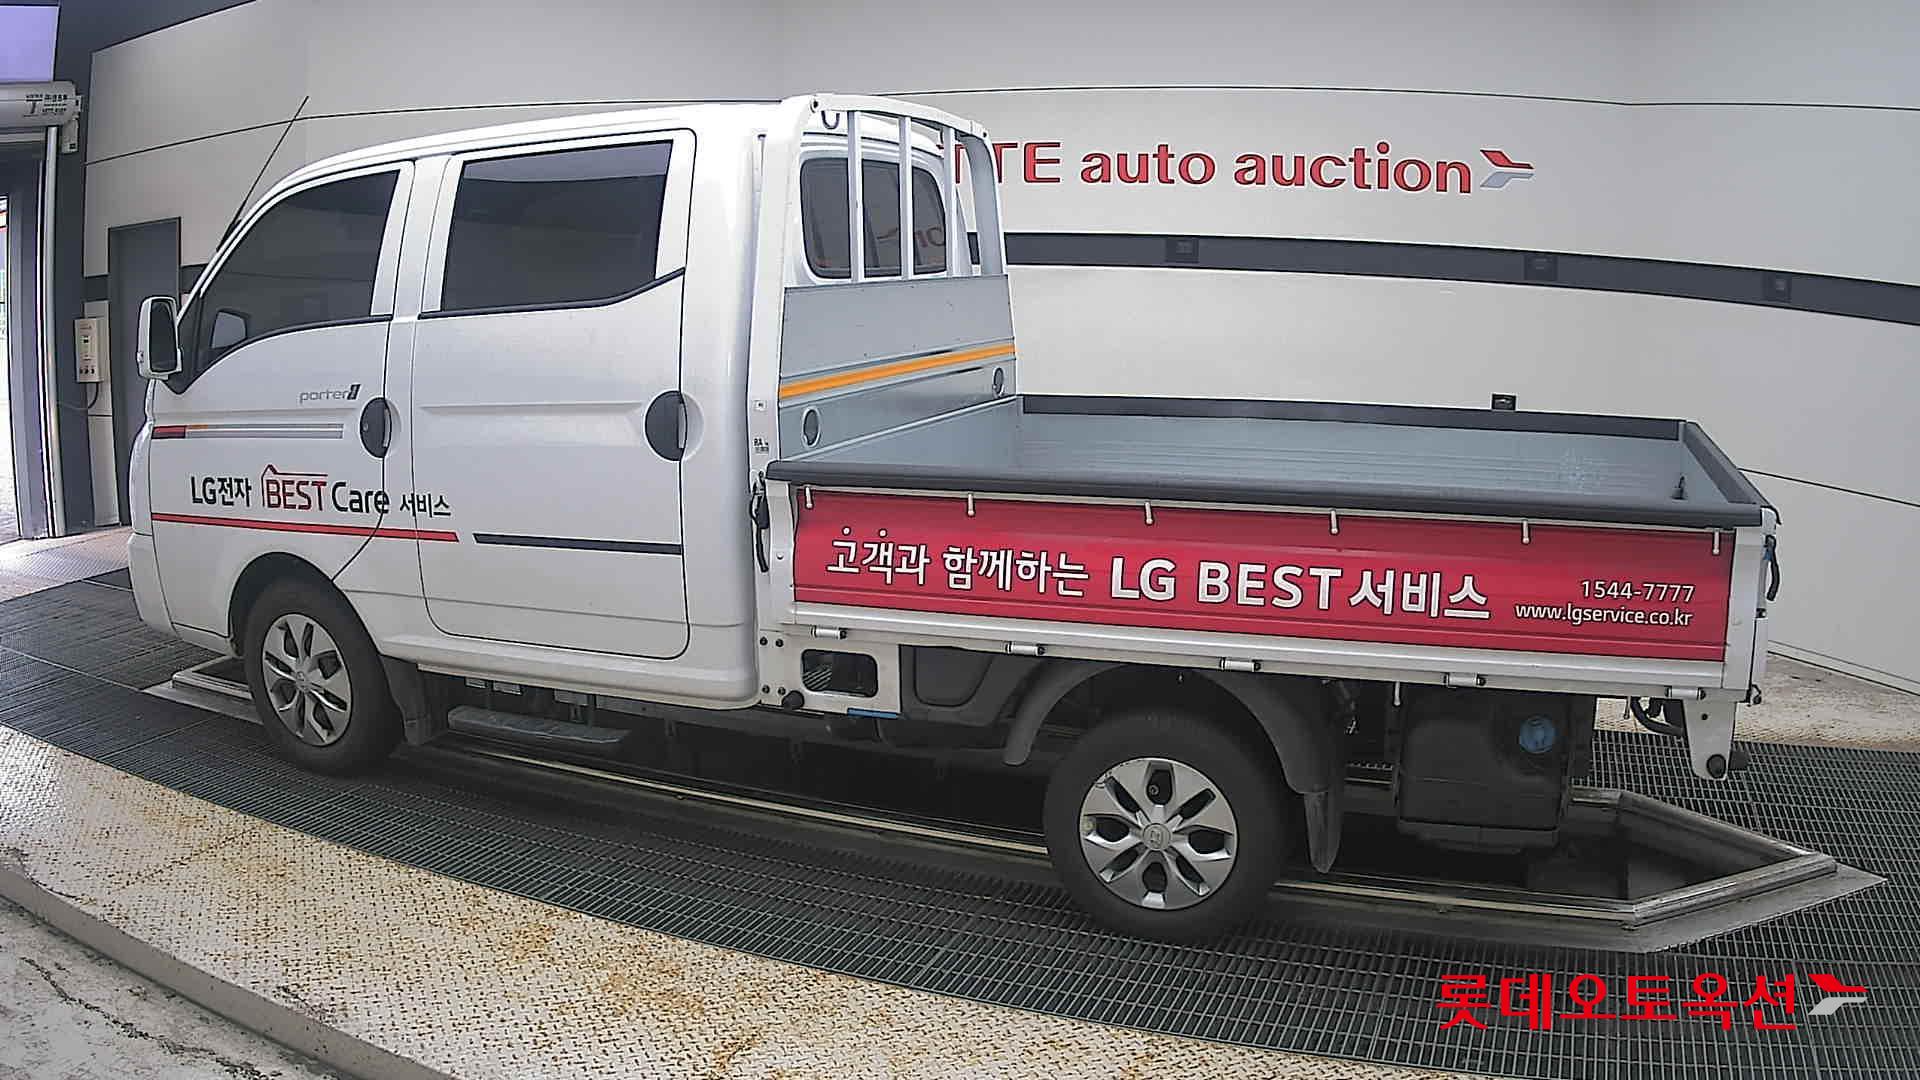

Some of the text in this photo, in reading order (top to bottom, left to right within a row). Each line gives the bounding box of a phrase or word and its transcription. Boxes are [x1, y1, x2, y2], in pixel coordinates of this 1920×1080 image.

[1080, 143, 1216, 185] auto
[1234, 141, 1472, 194] auction
[190, 475, 452, 519] LG전자 BEST Care 서비스
[826, 528, 931, 586] 고객과
[942, 546, 1090, 598] 함께하는
[1110, 556, 1177, 602] LG
[1581, 580, 1695, 603] 1544-7777
[1514, 602, 1693, 627] www.lgservice.co.kr
